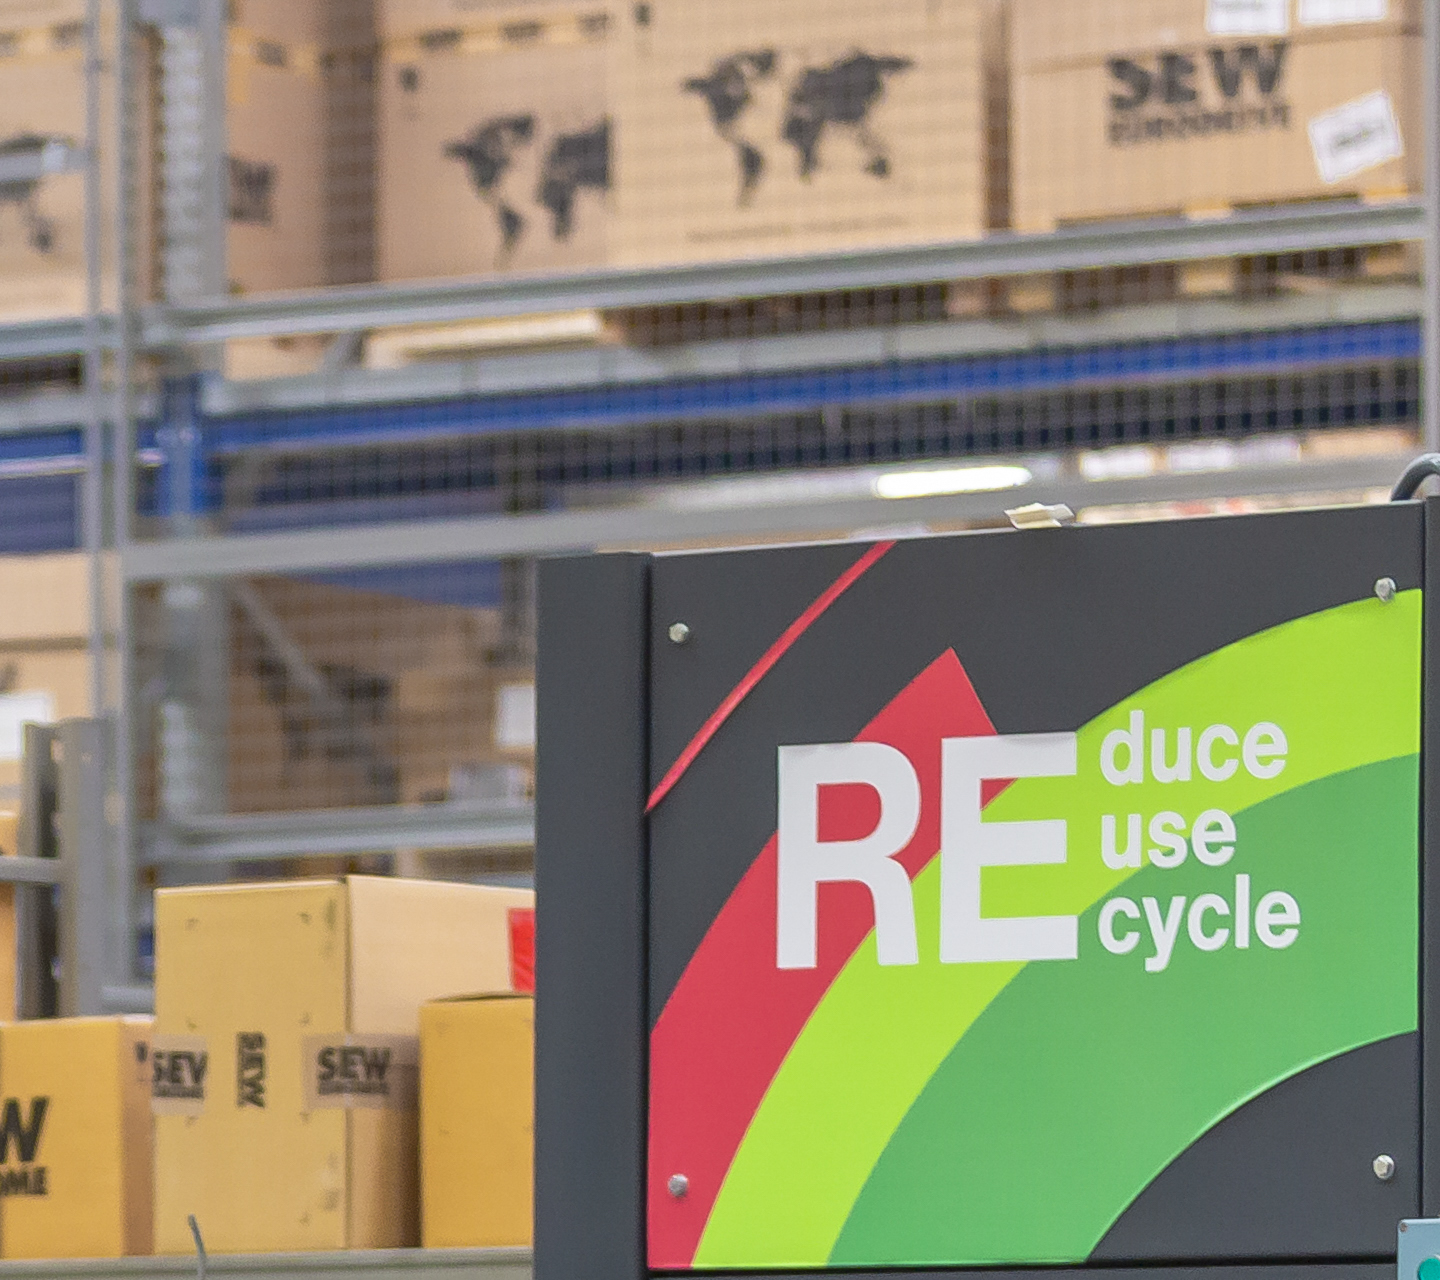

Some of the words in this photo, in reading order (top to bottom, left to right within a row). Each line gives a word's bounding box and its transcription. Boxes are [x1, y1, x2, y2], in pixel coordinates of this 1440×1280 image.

[1106, 40, 1289, 111] SEW
[1099, 709, 1290, 786] duce
[776, 732, 1079, 970] RE
[1100, 807, 1237, 870] use
[1097, 873, 1302, 973] cycle
[237, 1032, 266, 1108] SEW
[318, 1046, 390, 1080] SEW
